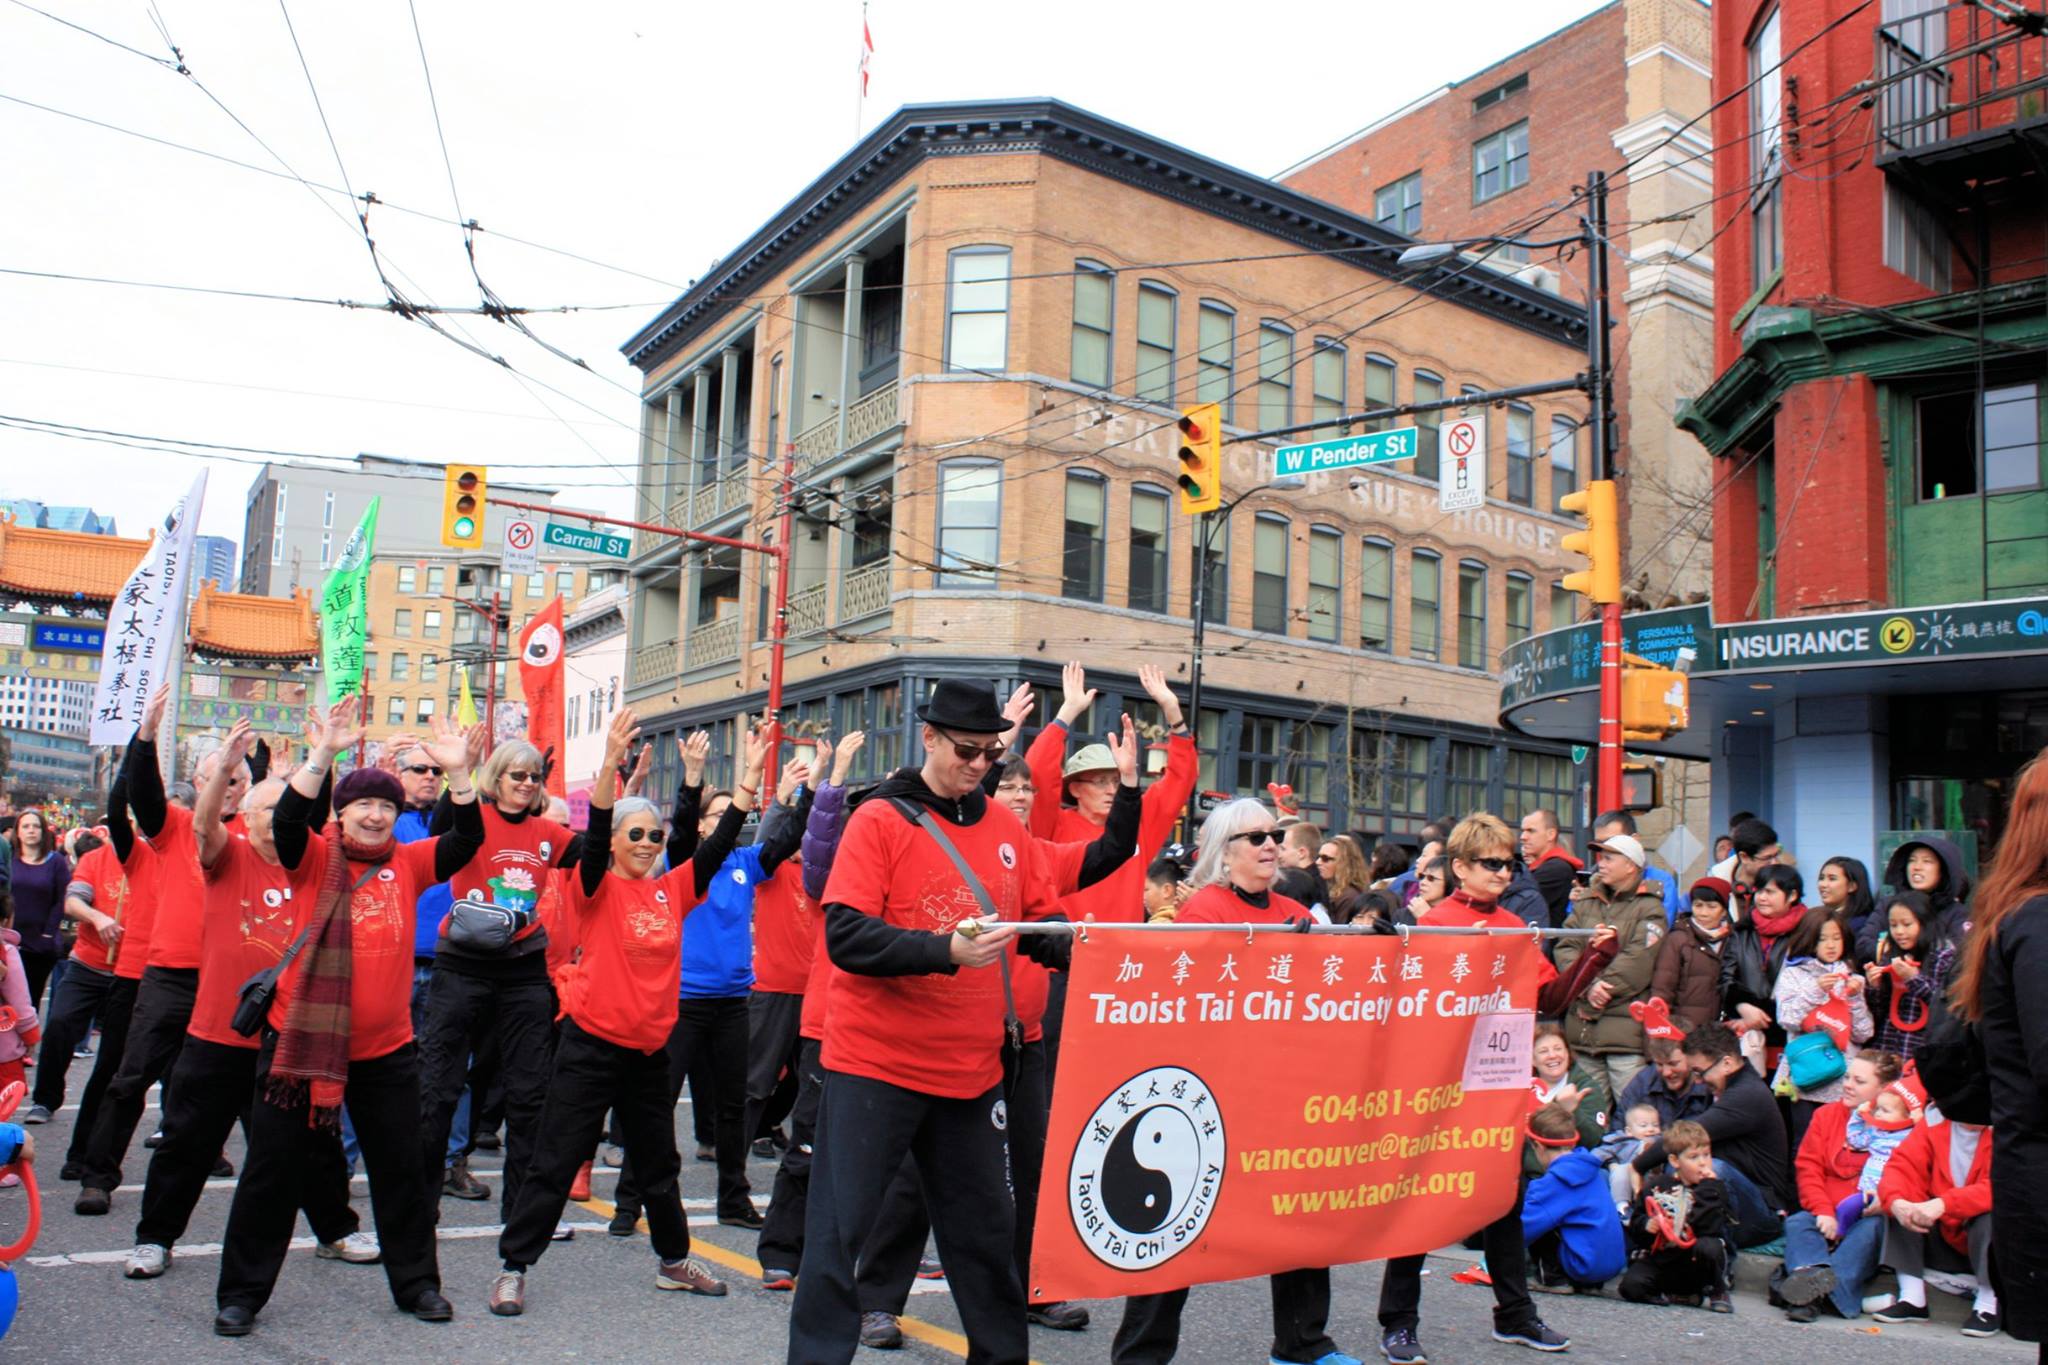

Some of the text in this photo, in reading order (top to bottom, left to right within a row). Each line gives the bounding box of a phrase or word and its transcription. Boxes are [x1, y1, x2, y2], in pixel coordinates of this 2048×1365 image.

[1285, 435, 1407, 471] W Pender St
[1444, 496, 1479, 508] BICYCLES
[1448, 488, 1476, 500] EXCEPT
[551, 527, 624, 555] Carrall St
[1452, 509, 1557, 556] HOUSE
[143, 636, 156, 659] CHI
[1638, 623, 1694, 640] PERSONAL &
[1638, 635, 1697, 651] COMMERCIAL
[1721, 627, 1870, 661] INSURANCE
[1115, 950, 1506, 986] 加拿大道家太極拳社
[1089, 985, 1512, 1026] Taoist Tai Chi Society of Canada
[1487, 1031, 1511, 1052] 40
[1303, 1081, 1465, 1124] 604-681-6609
[1239, 1125, 1516, 1173] vancouver@taoist.org
[1271, 1170, 1476, 1216] www.taoist.org
[1078, 1163, 1220, 1260] Taoist Tai Chi Society
